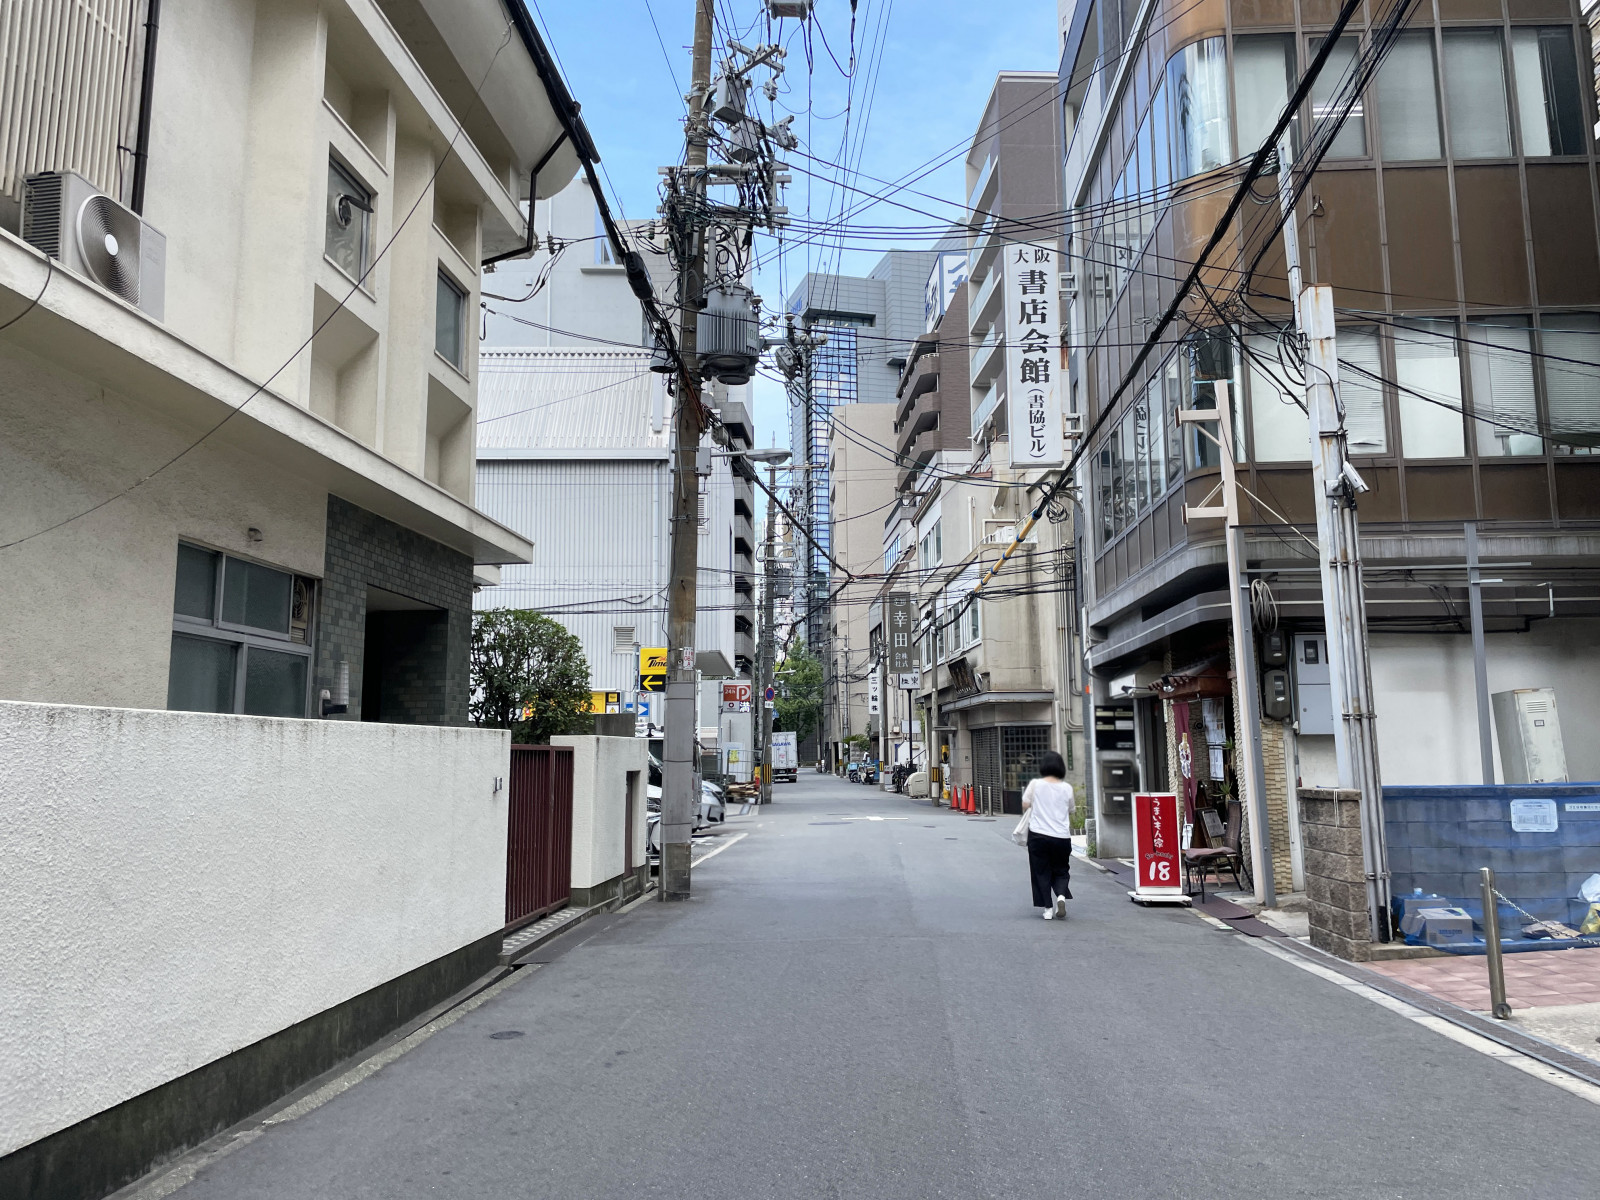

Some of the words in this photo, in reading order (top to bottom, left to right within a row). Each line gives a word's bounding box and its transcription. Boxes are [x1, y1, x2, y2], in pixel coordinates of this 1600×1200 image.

[1013, 248, 1050, 264] 大阪
[1018, 269, 1050, 384] 書店会館
[893, 610, 908, 648] 幸田
[736, 685, 751, 701] P
[1149, 861, 1171, 881] 18
